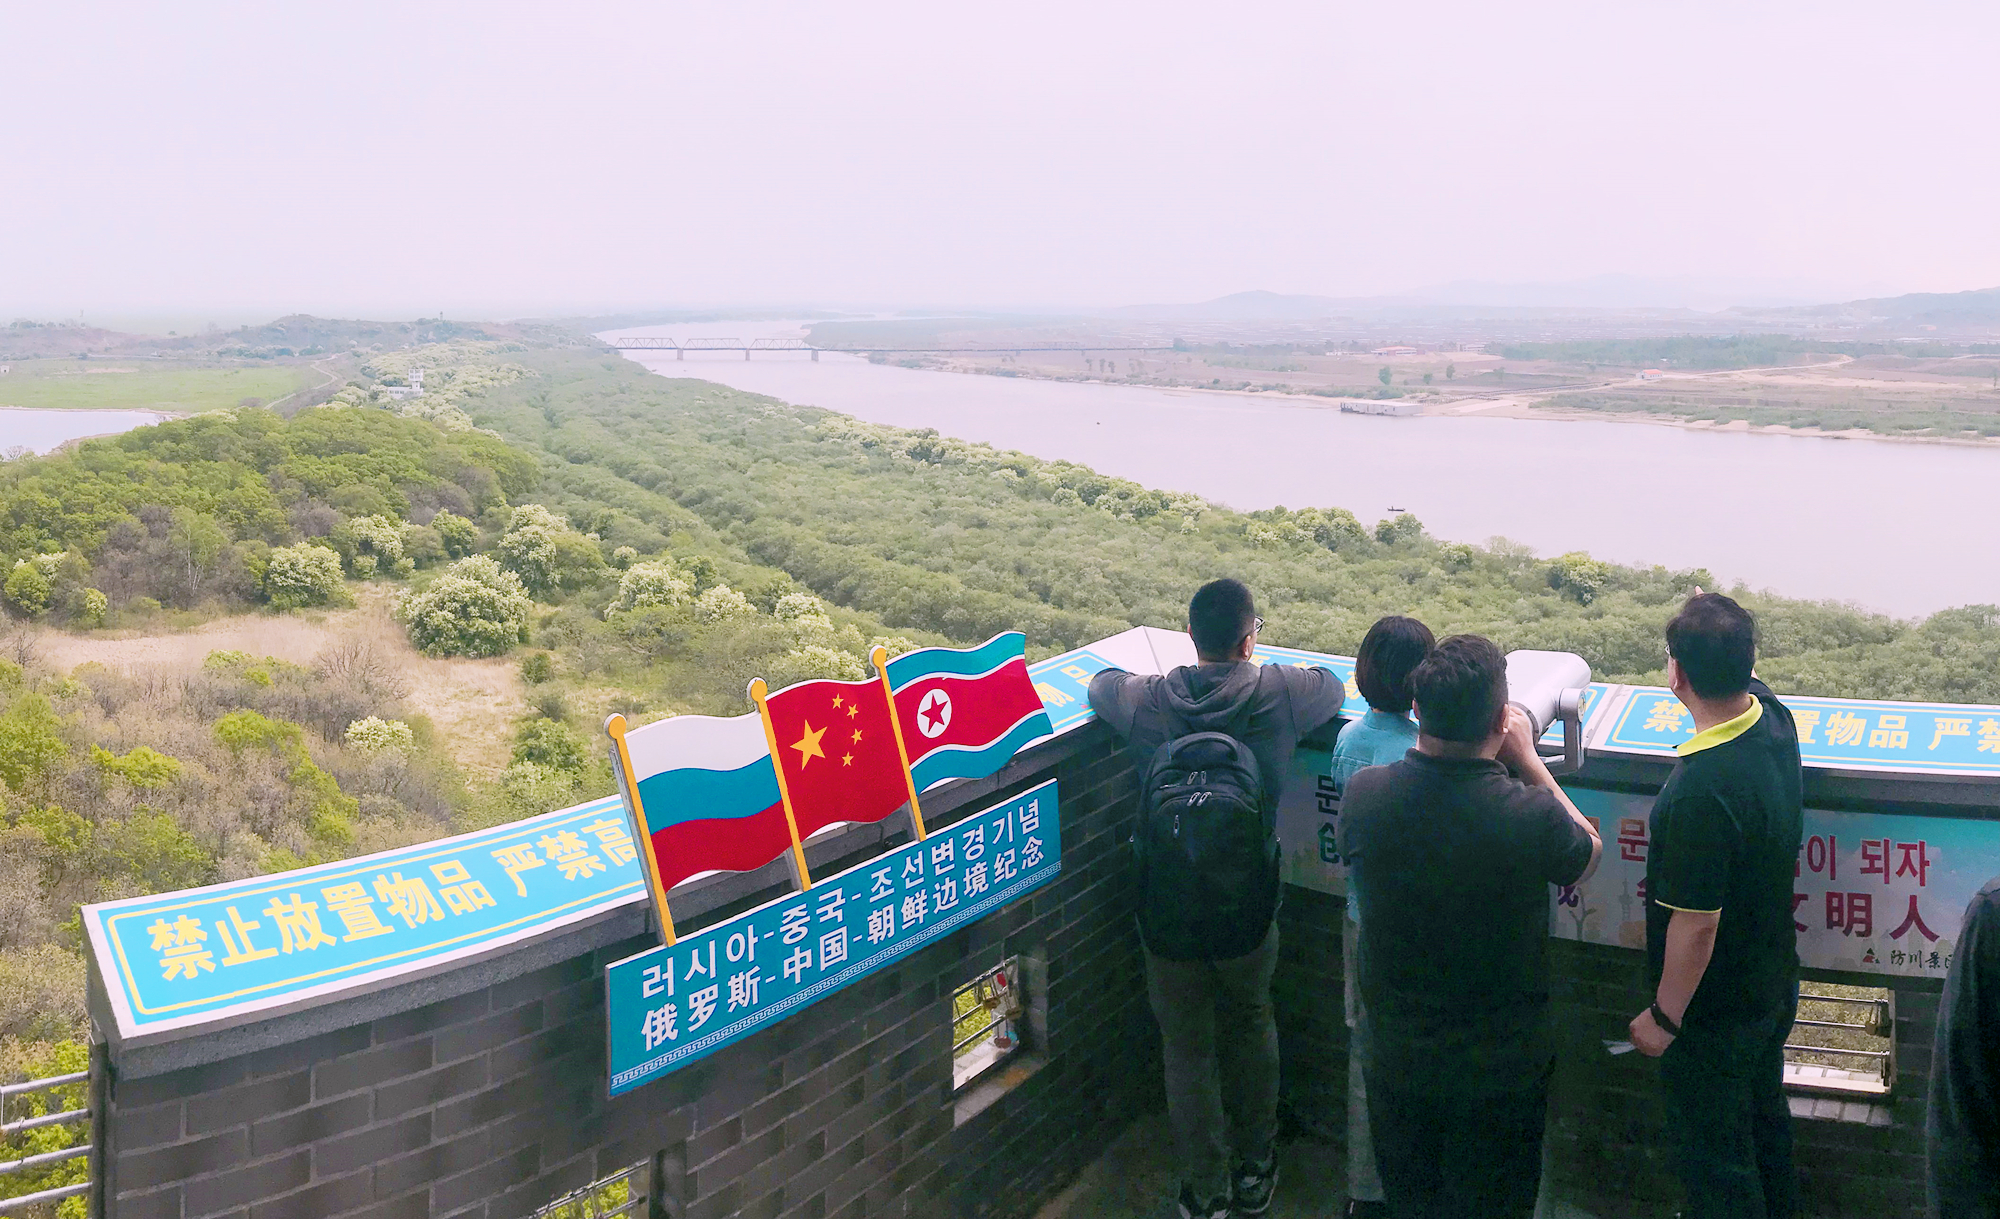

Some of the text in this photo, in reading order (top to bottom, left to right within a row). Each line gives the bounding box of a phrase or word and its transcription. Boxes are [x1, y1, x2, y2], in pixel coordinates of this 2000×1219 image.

[1860, 839, 1930, 887] 되자
[147, 861, 495, 980] 禁止放置物品
